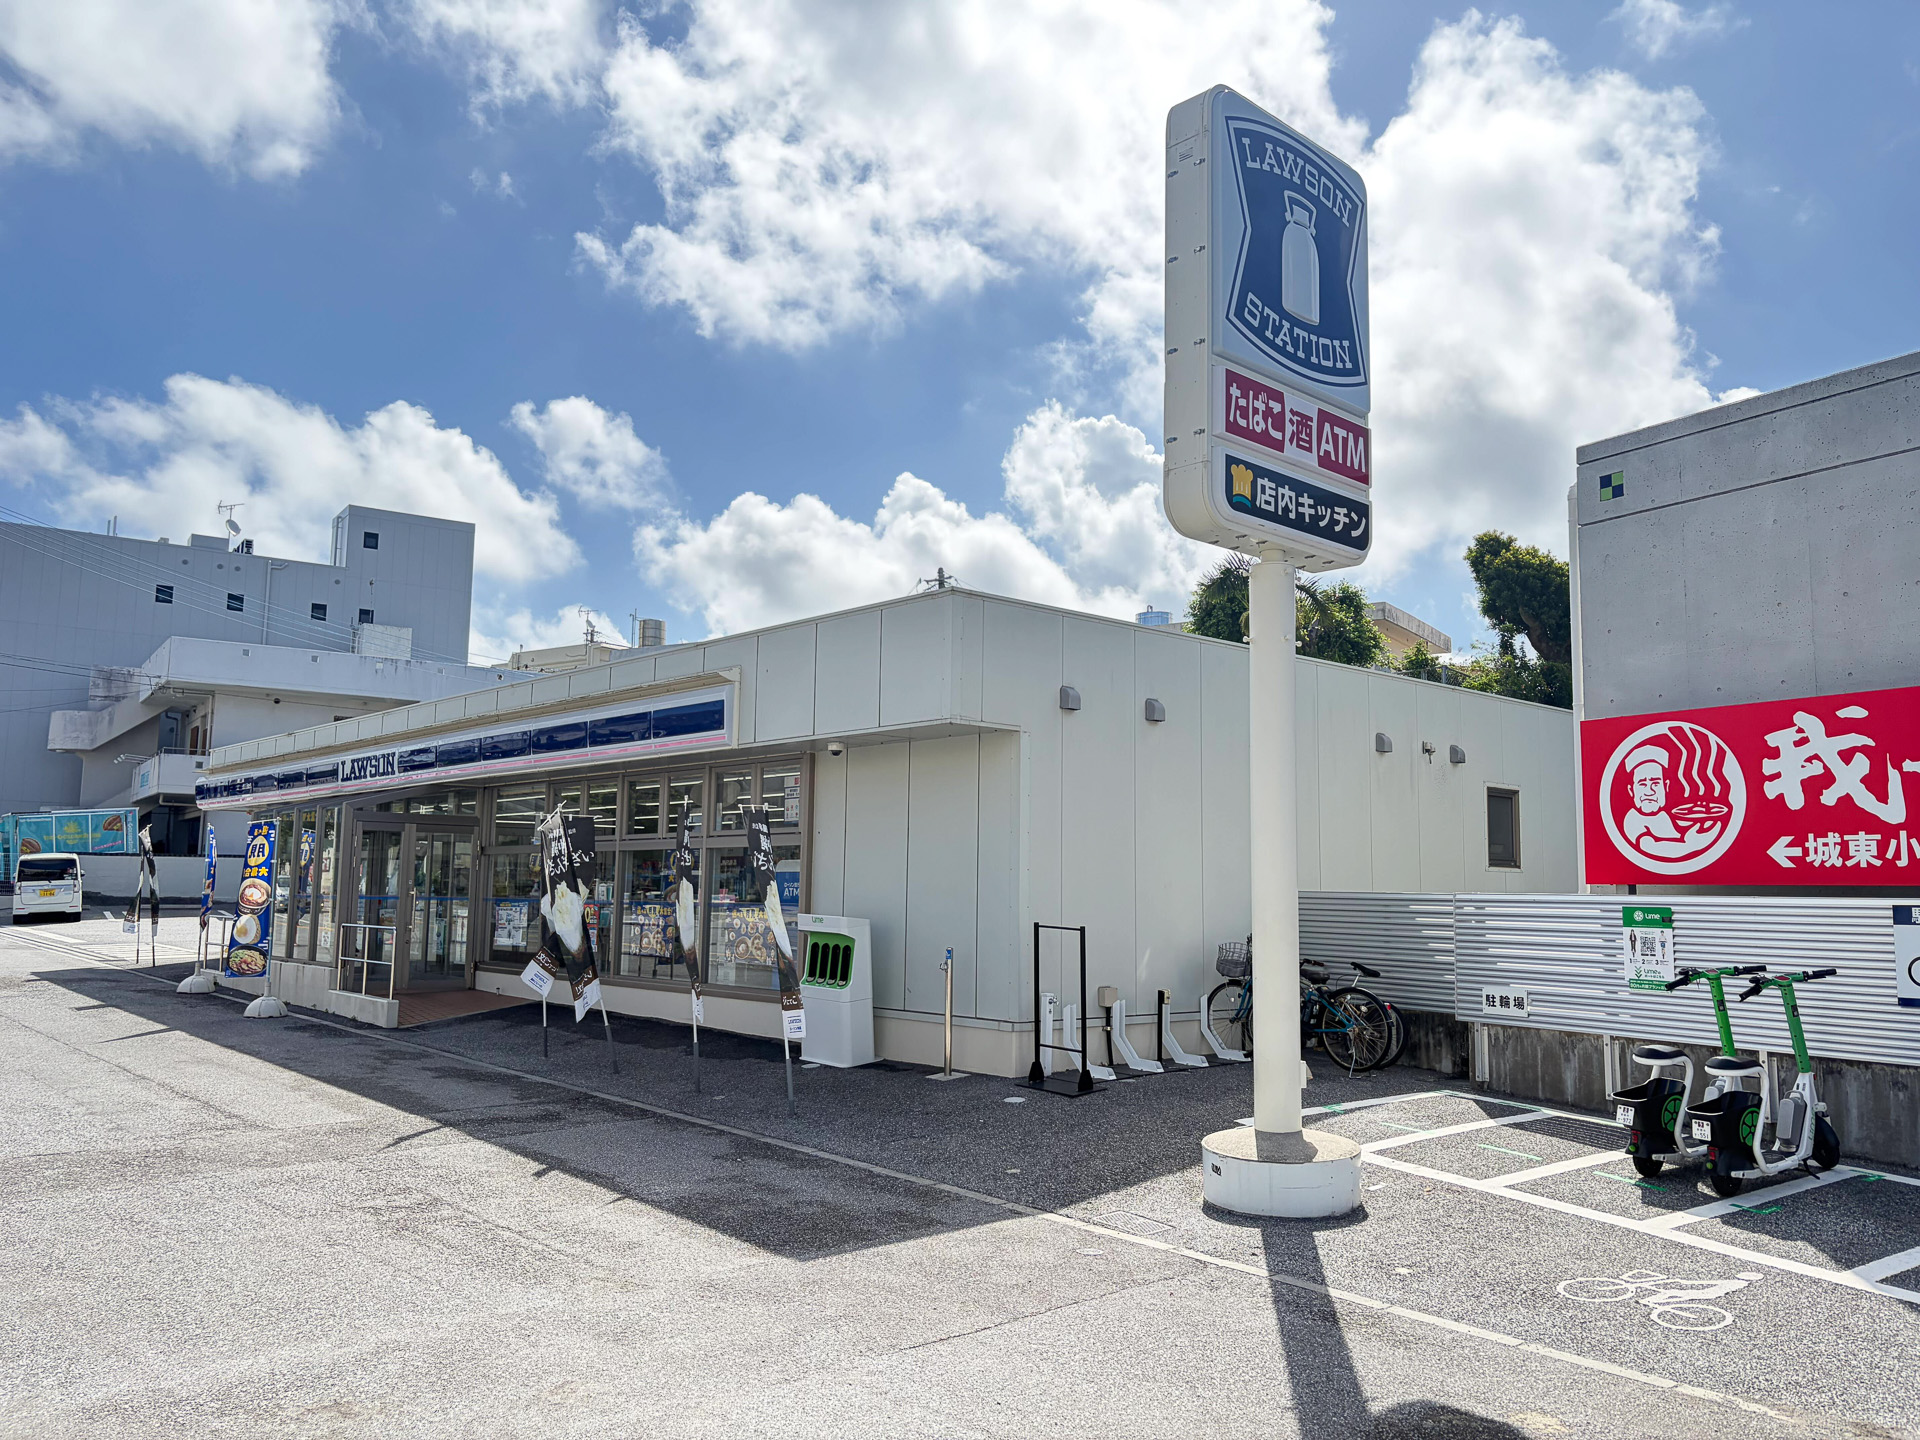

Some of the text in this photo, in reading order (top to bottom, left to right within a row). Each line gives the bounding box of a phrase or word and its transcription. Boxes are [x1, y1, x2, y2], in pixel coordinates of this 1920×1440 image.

[1242, 137, 1352, 228] LAWSON
[1244, 292, 1353, 369] STATION
[1229, 382, 1366, 473] たばこ 酒 ATM
[1255, 478, 1367, 538] 店内キッチン
[340, 751, 397, 783] LAWSON
[783, 887, 800, 897] ATM
[811, 916, 824, 924] Lime
[1485, 993, 1525, 1010] 駐輪場
